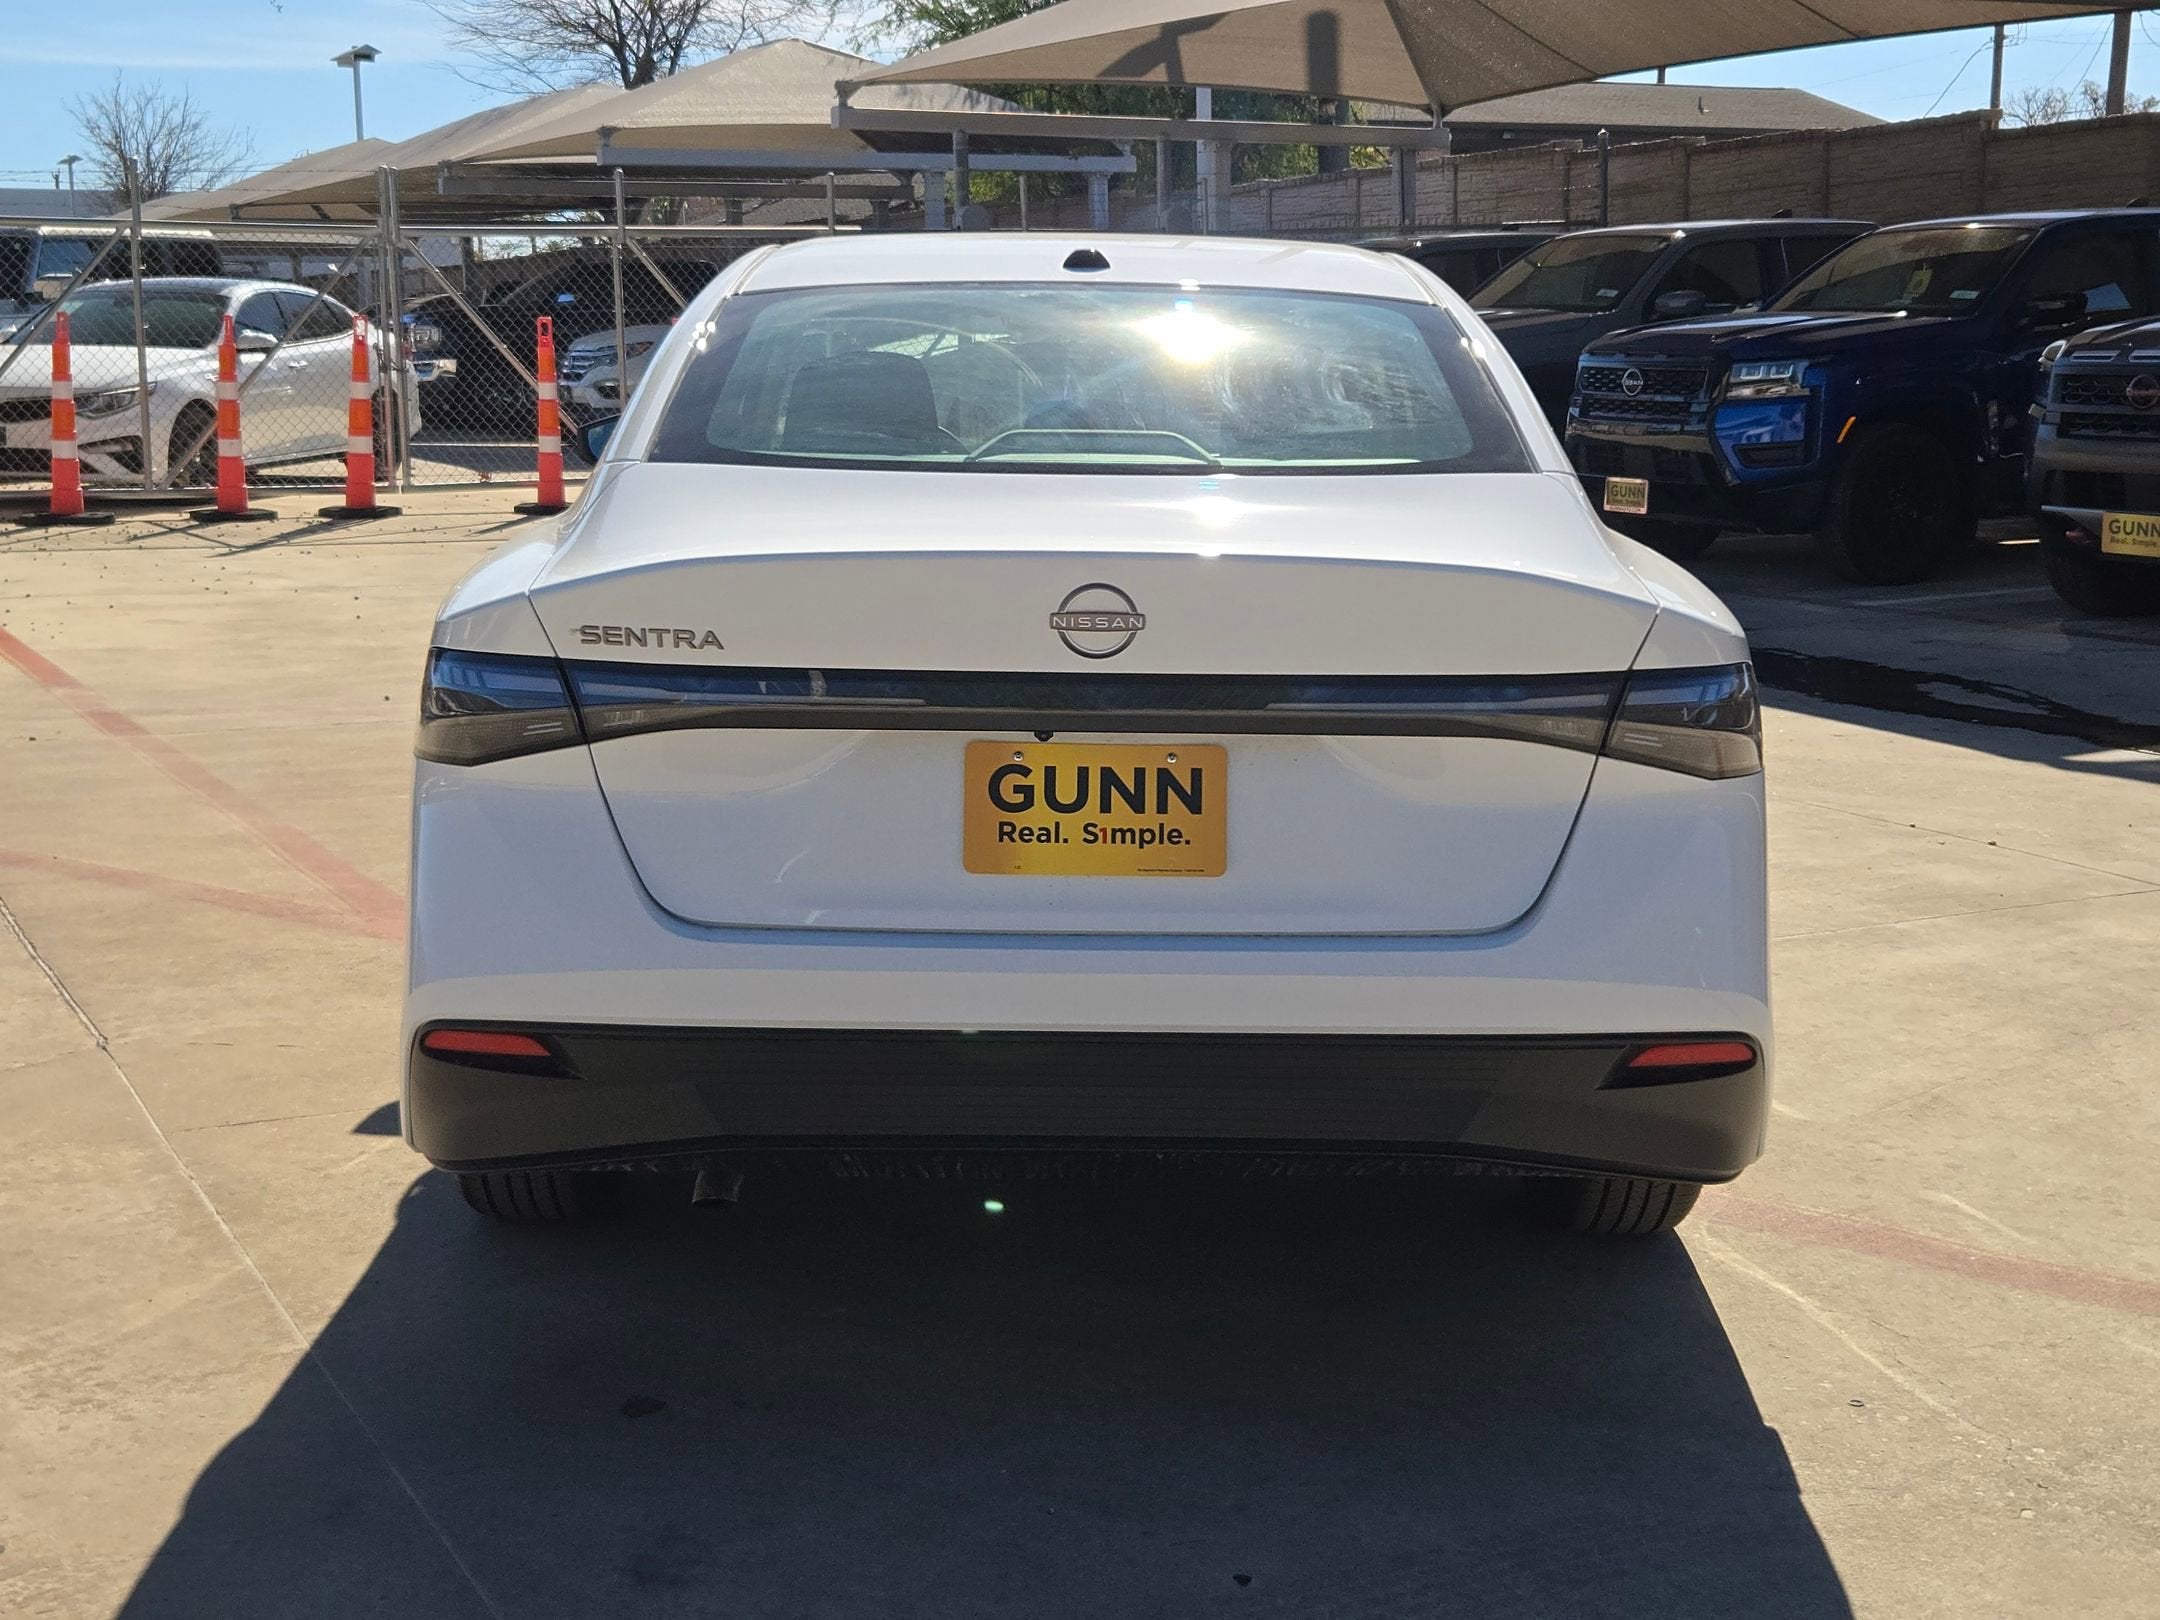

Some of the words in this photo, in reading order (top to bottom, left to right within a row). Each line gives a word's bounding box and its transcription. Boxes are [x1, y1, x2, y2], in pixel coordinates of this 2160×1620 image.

[1610, 484, 1645, 499] GUNN
[2109, 519, 2160, 537] GUNN
[1053, 616, 1143, 628] NISSAN
[579, 624, 725, 650] SENTRA
[988, 763, 1203, 815] GUNN
[998, 821, 1069, 844] Real.
